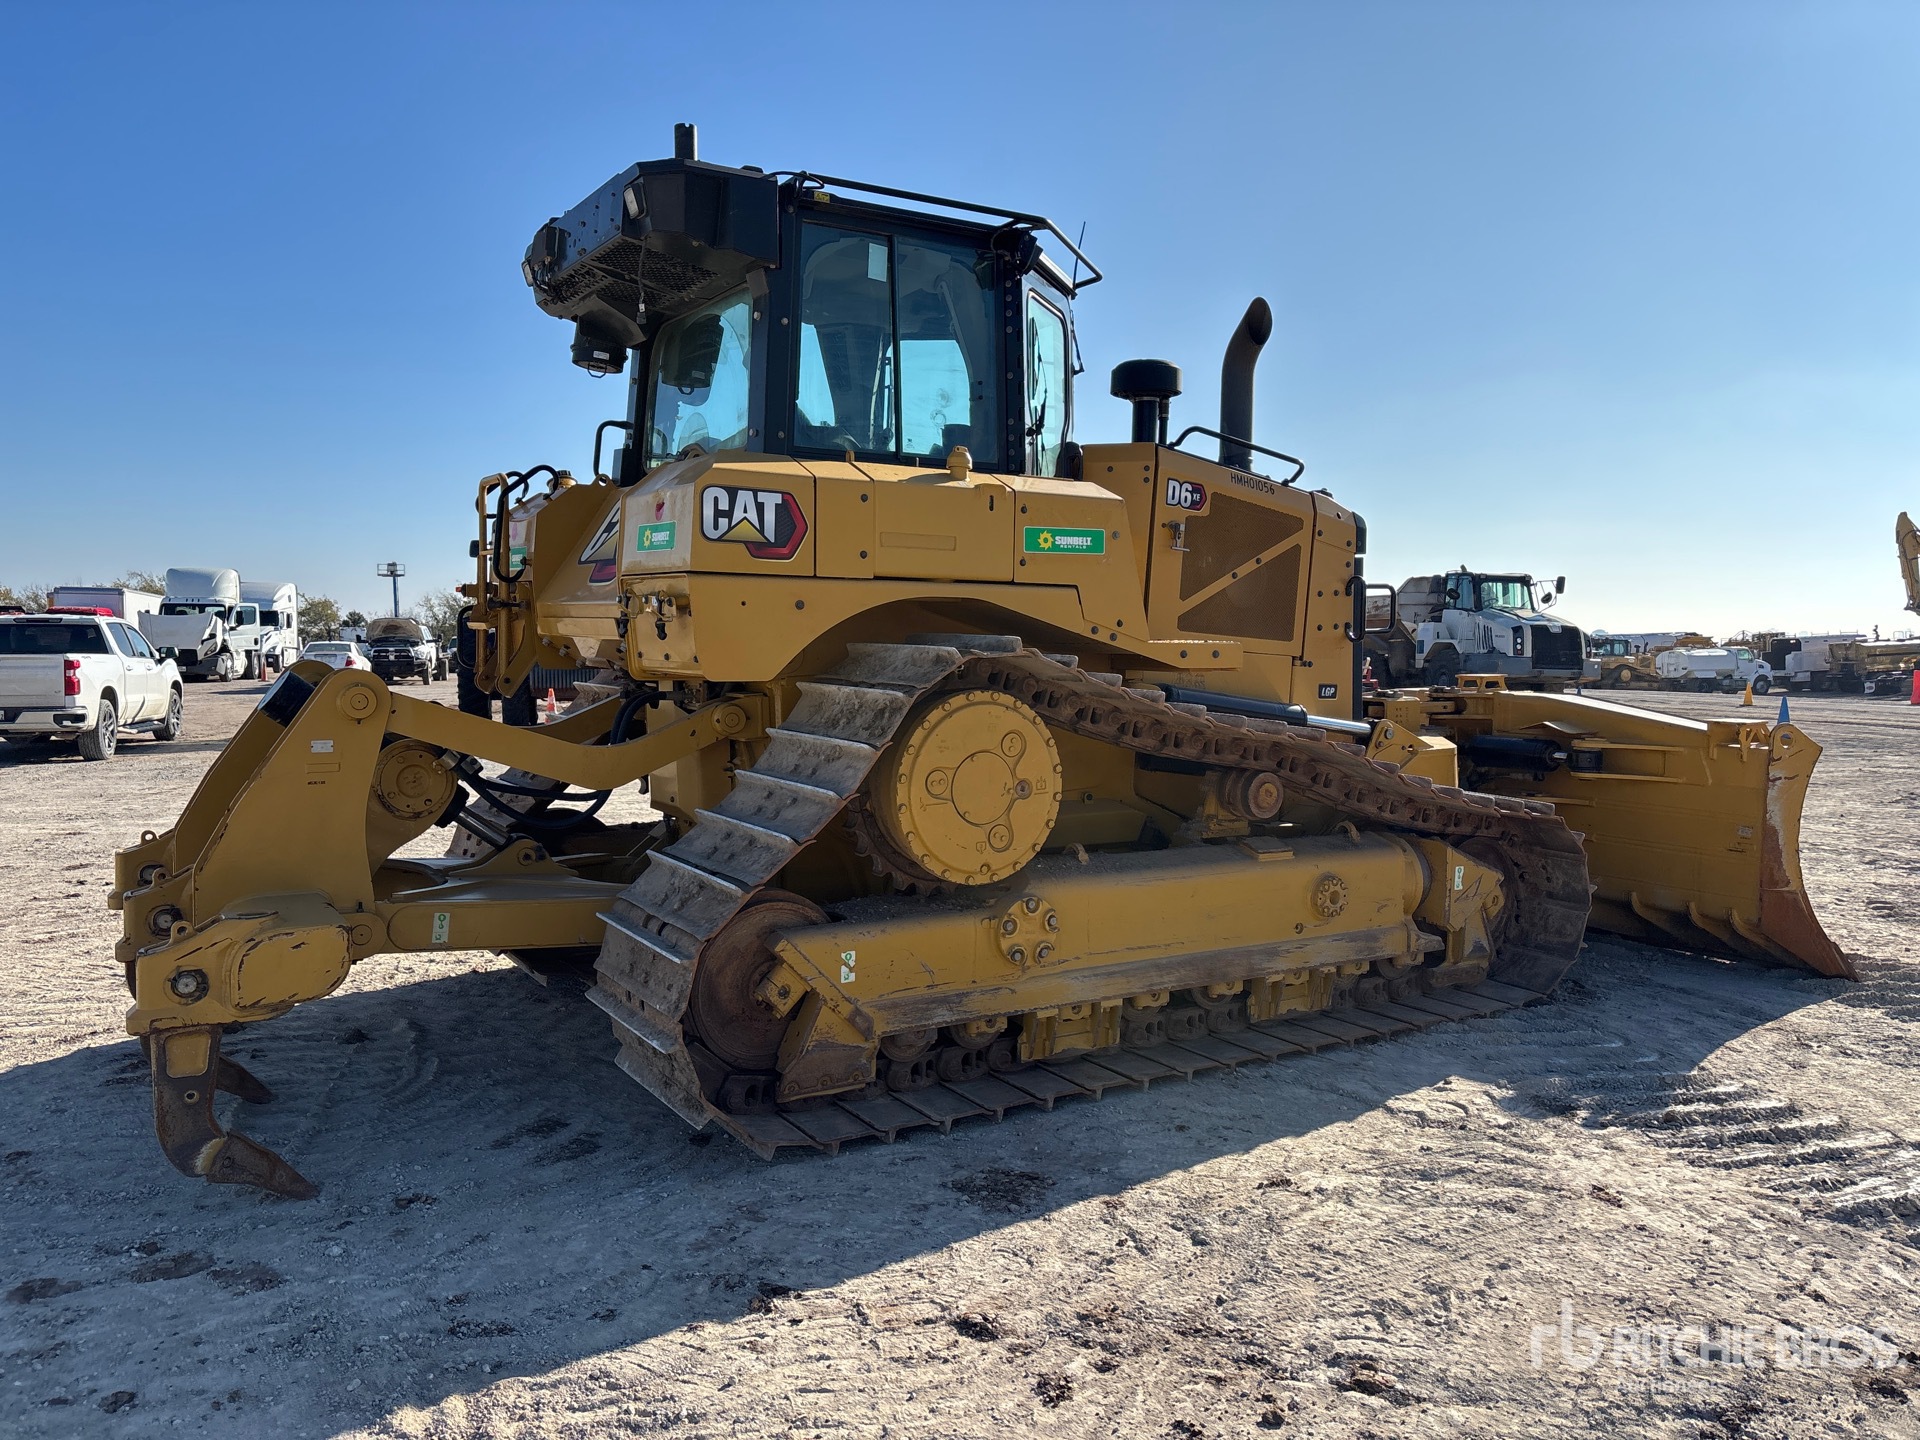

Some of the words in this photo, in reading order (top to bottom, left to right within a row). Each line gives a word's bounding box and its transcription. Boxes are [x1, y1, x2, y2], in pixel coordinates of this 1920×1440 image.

[1167, 479, 1193, 508] D6
[1230, 472, 1275, 495] HMH01056
[702, 486, 782, 543] CAT
[1055, 535, 1092, 546] SUNBELT
[1321, 687, 1335, 697] LGP
